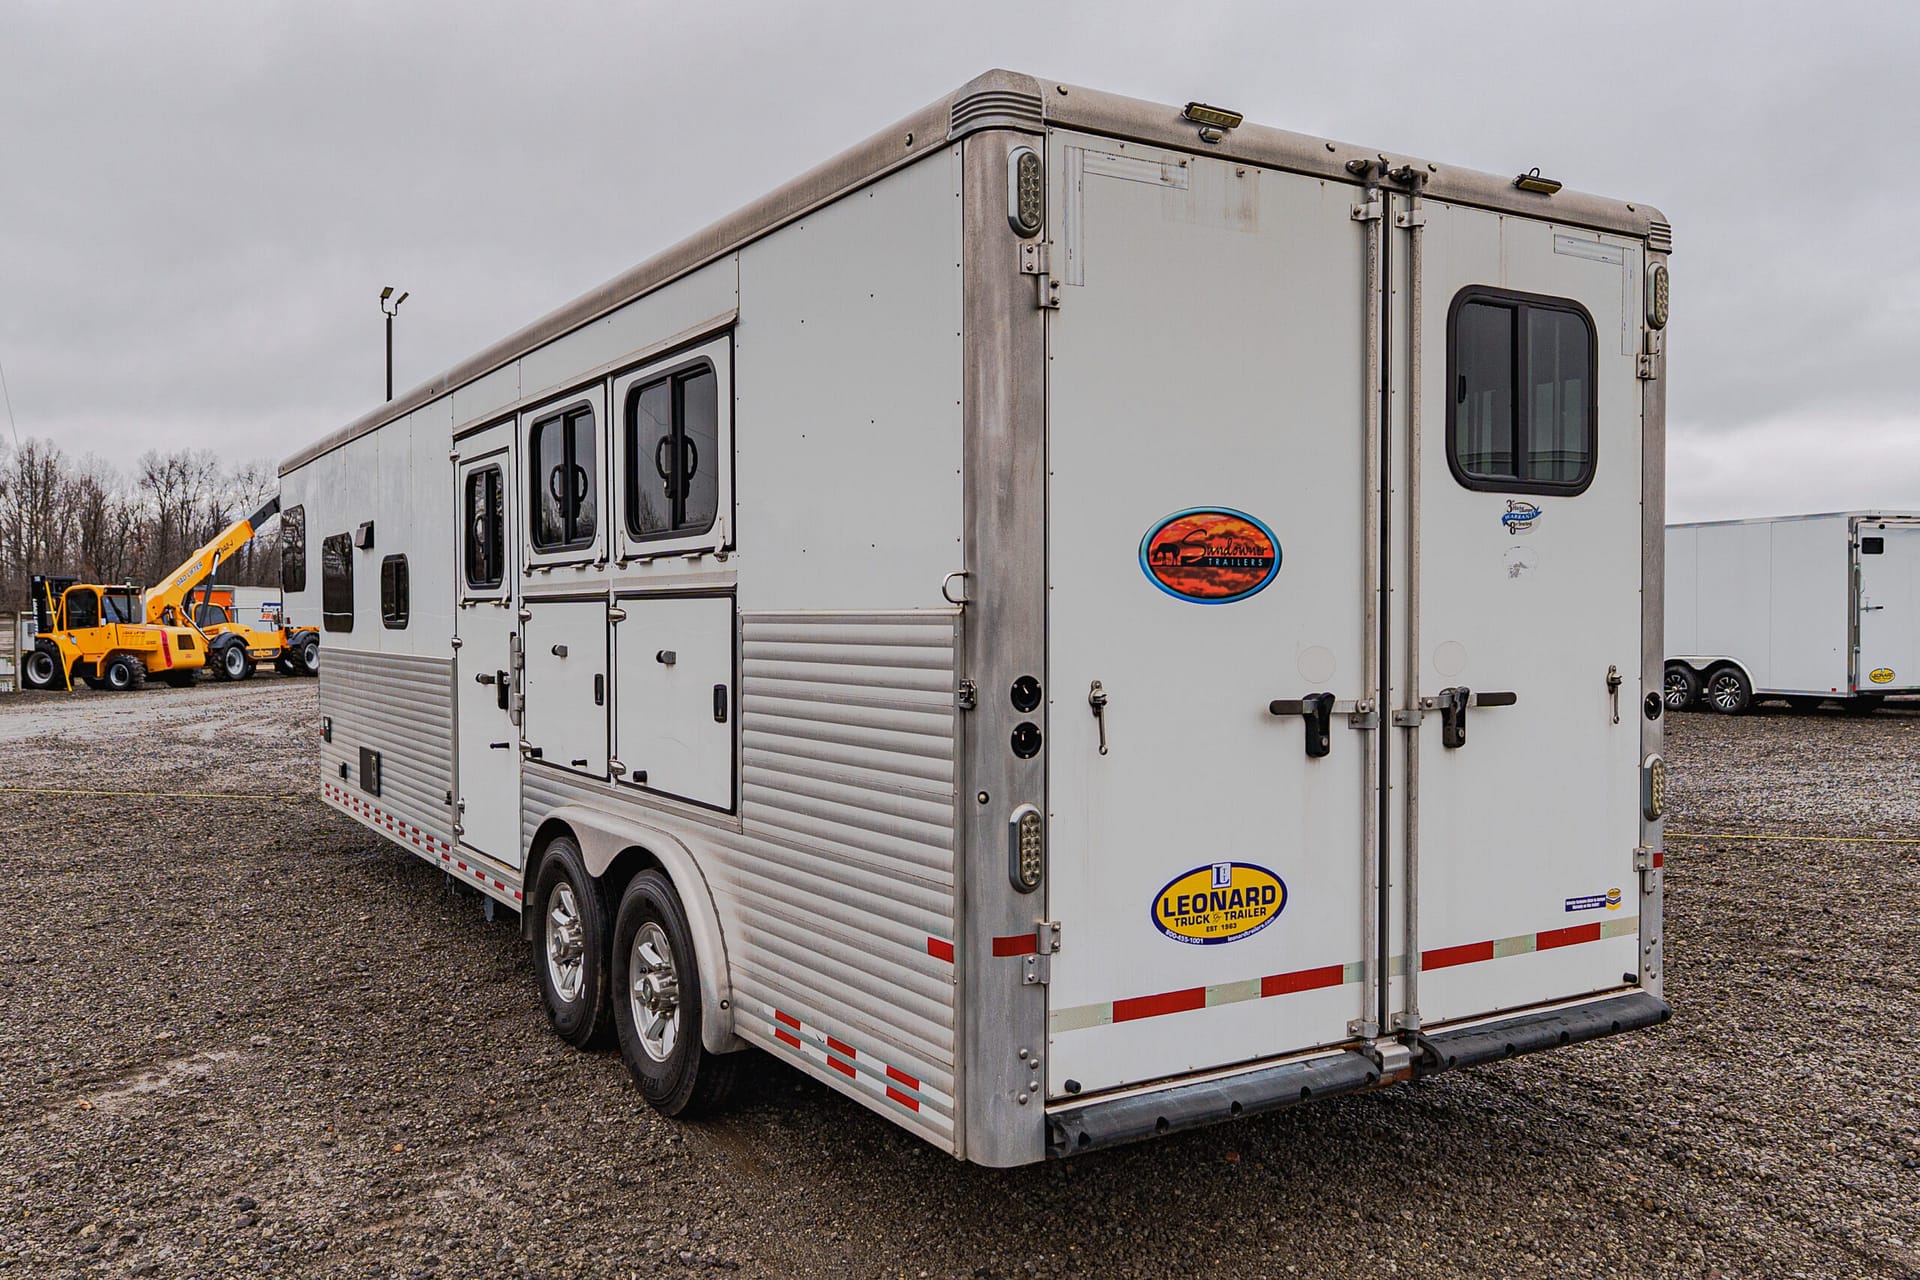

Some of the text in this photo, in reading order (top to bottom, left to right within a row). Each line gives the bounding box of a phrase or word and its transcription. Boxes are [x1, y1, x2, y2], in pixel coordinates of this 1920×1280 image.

[1181, 528, 1268, 563] Sundowner
[1208, 558, 1263, 566] TRAILERS
[1163, 885, 1276, 918] LEONARD
[1174, 914, 1210, 927] TRUCK
[1223, 907, 1266, 921] TRAILER
